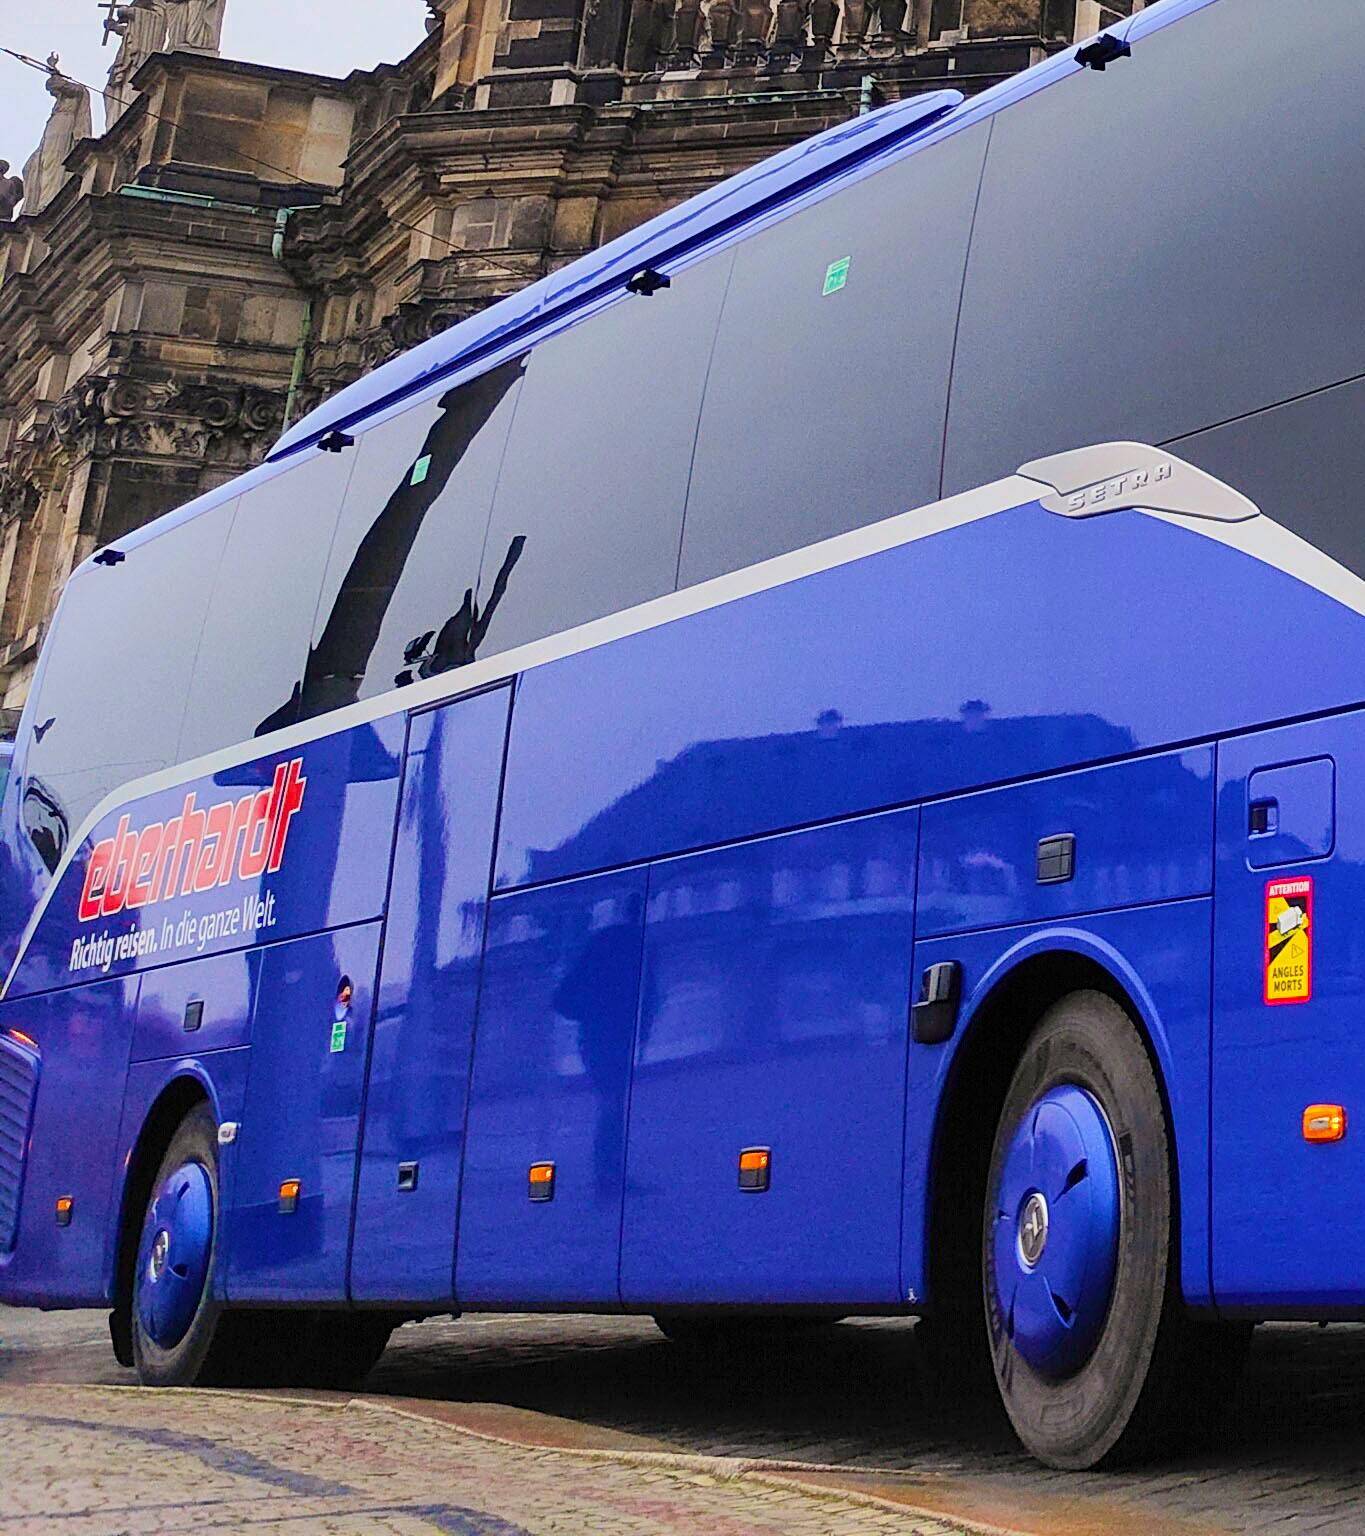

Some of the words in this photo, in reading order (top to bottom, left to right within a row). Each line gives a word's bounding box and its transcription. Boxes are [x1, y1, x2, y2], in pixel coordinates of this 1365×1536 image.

[1067, 462, 1173, 513] SETRA
[78, 757, 308, 923] eberhardt
[1268, 880, 1310, 897] ATTENTION
[69, 928, 114, 973] Richtig
[114, 923, 158, 962] reisen.
[160, 917, 173, 951] In
[175, 910, 197, 945] die
[197, 906, 240, 952] ganze
[242, 889, 277, 932] Welt.
[1272, 964, 1304, 979] ANGLES
[1273, 979, 1303, 992] MORTS
